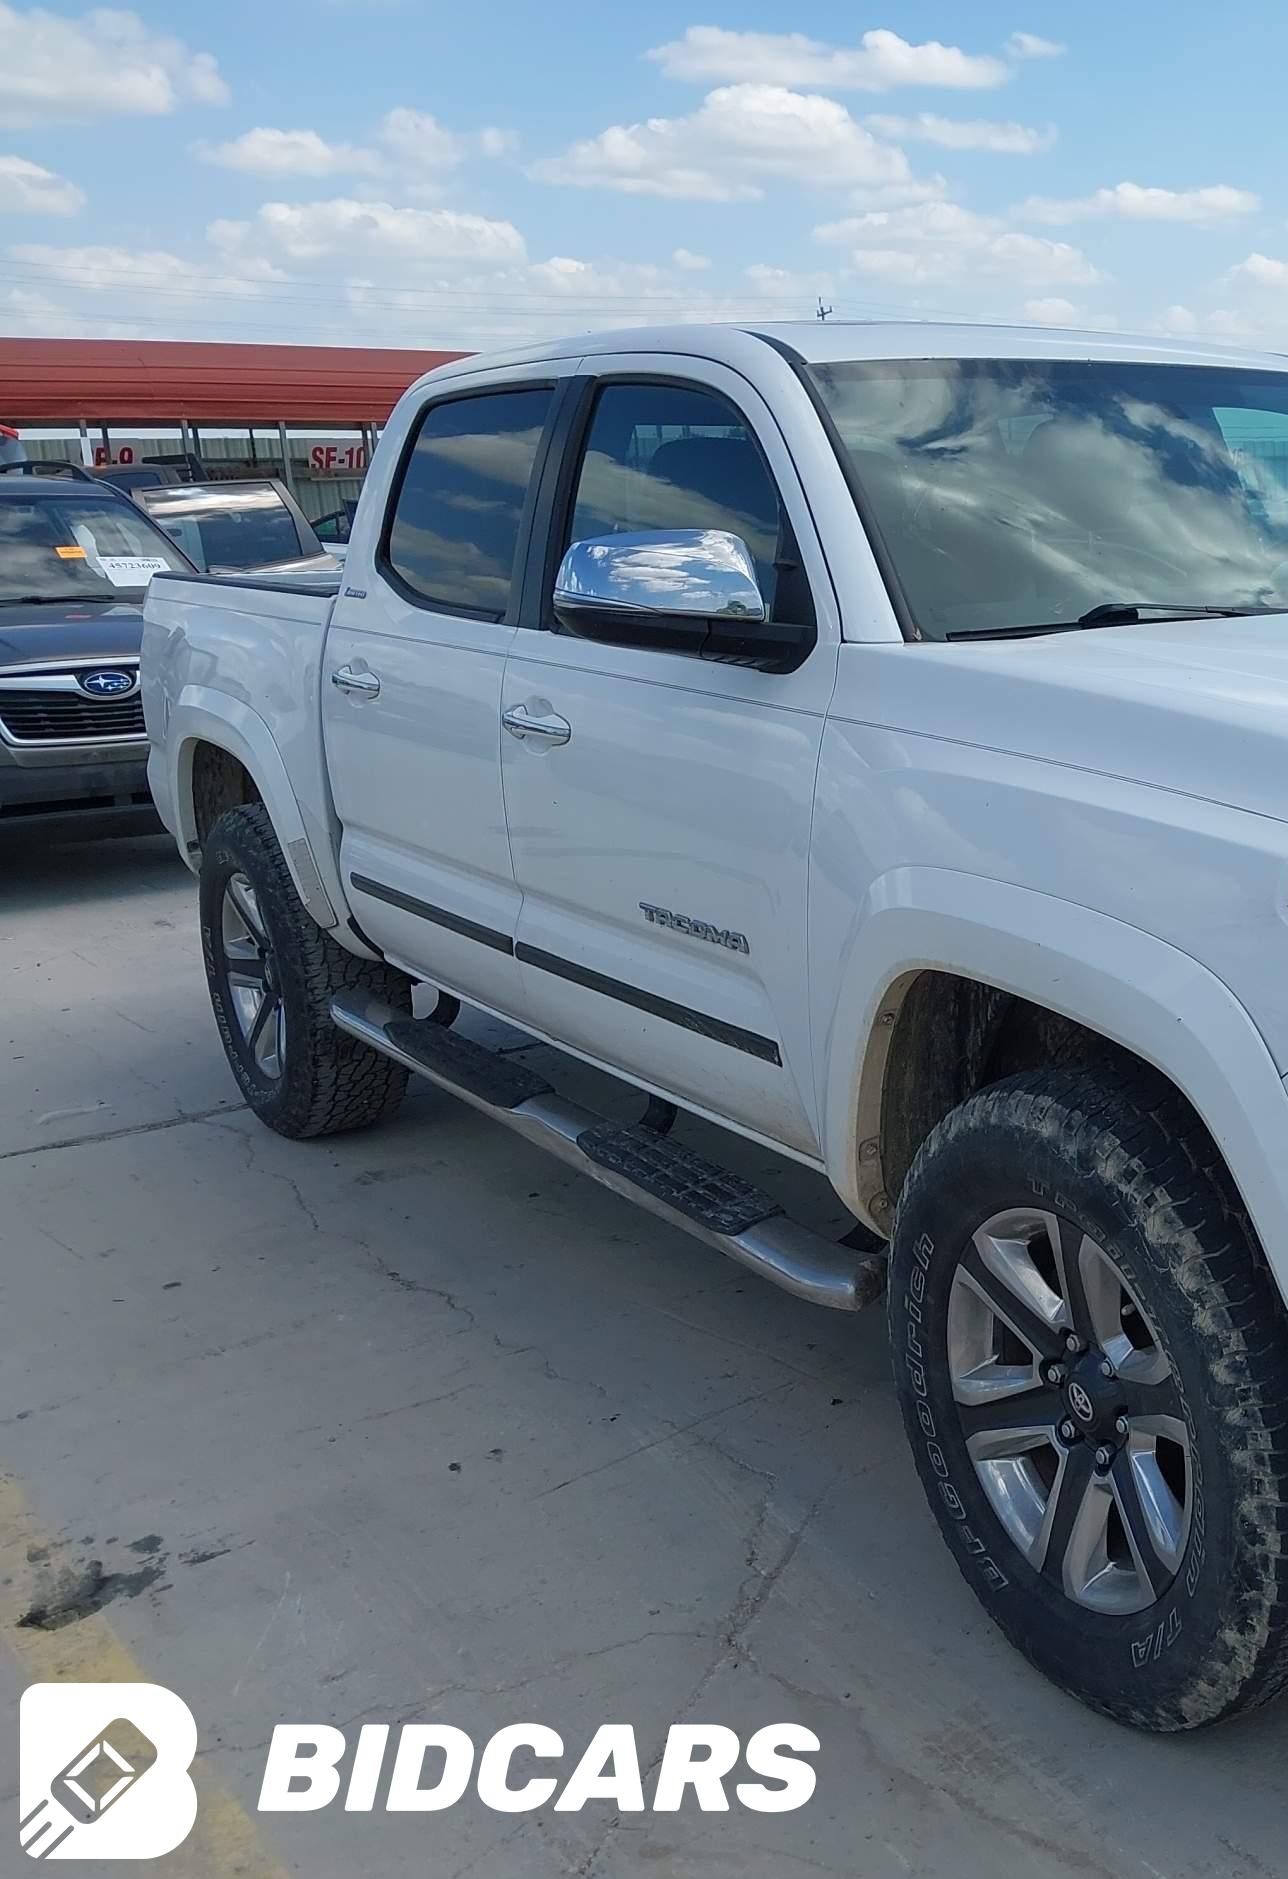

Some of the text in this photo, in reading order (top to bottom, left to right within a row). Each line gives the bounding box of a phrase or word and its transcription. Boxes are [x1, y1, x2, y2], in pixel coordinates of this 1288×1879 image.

[310, 446, 367, 470] SF-10
[638, 901, 750, 955] TACOMA
[903, 1232, 1010, 1592] BFGoodrich
[1131, 1607, 1183, 1669] T/A
